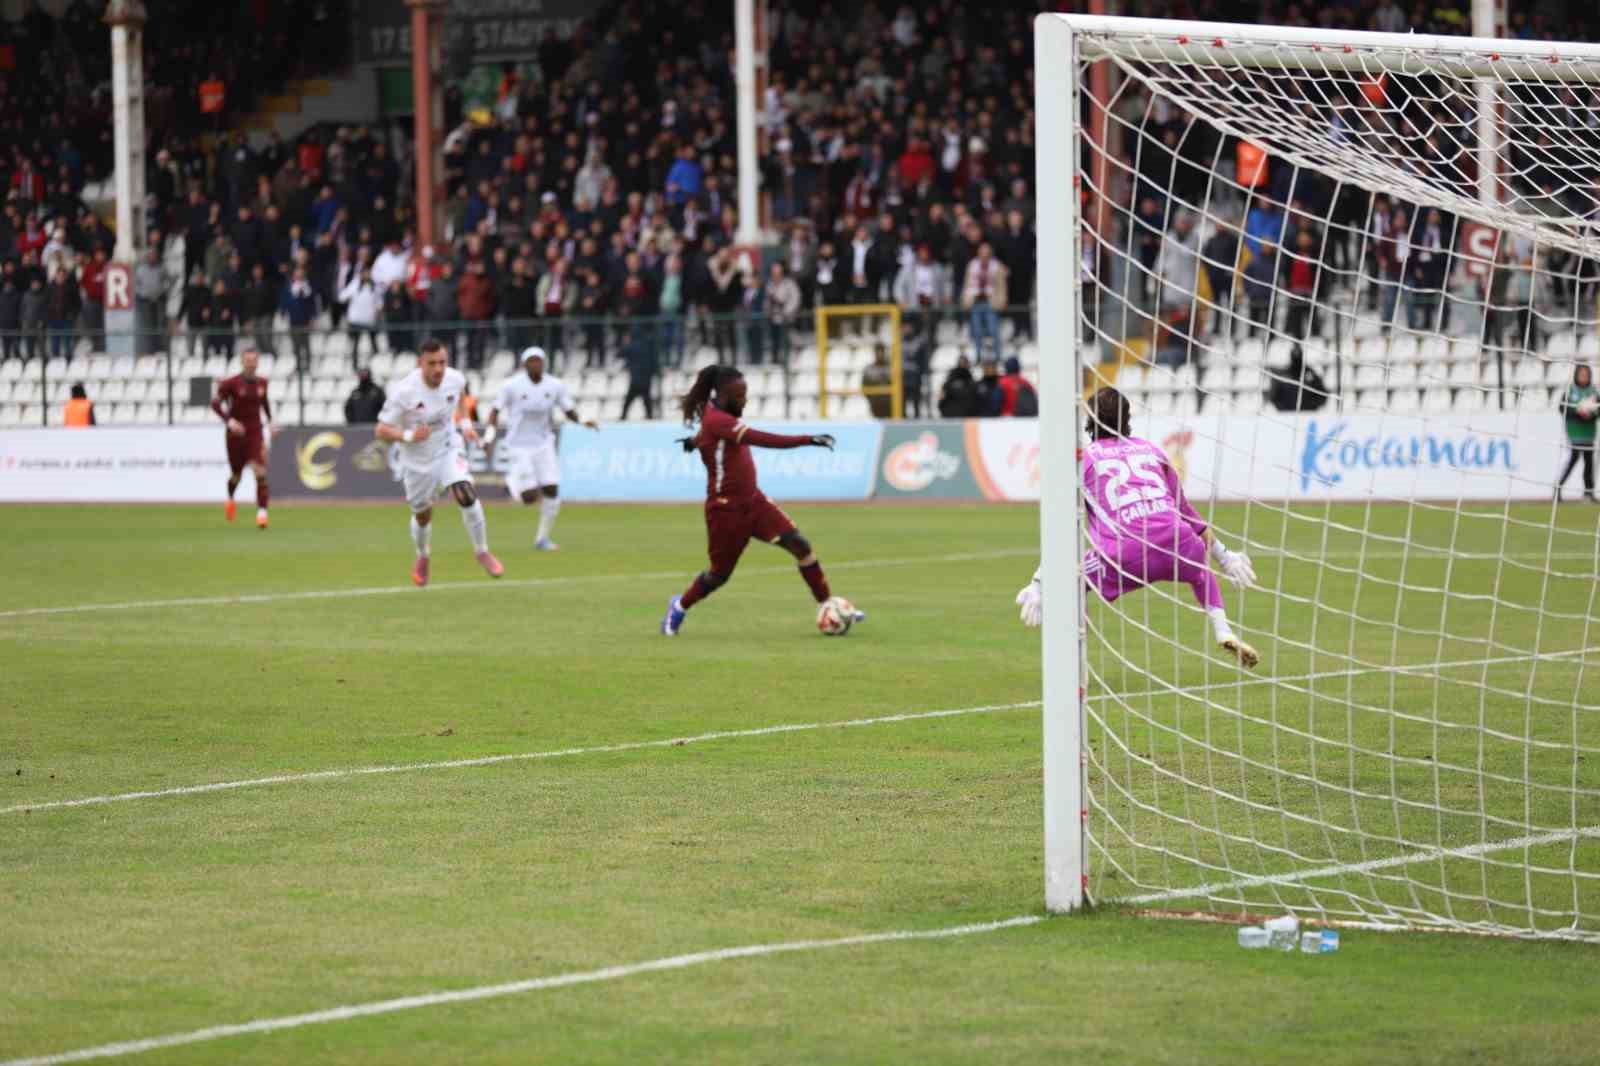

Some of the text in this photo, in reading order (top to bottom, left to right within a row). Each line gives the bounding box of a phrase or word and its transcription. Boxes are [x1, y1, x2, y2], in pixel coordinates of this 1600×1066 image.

[370, 26, 396, 55] 17
[106, 267, 129, 307] R
[1300, 419, 1521, 493] Kocaman
[1096, 453, 1168, 511] 25
